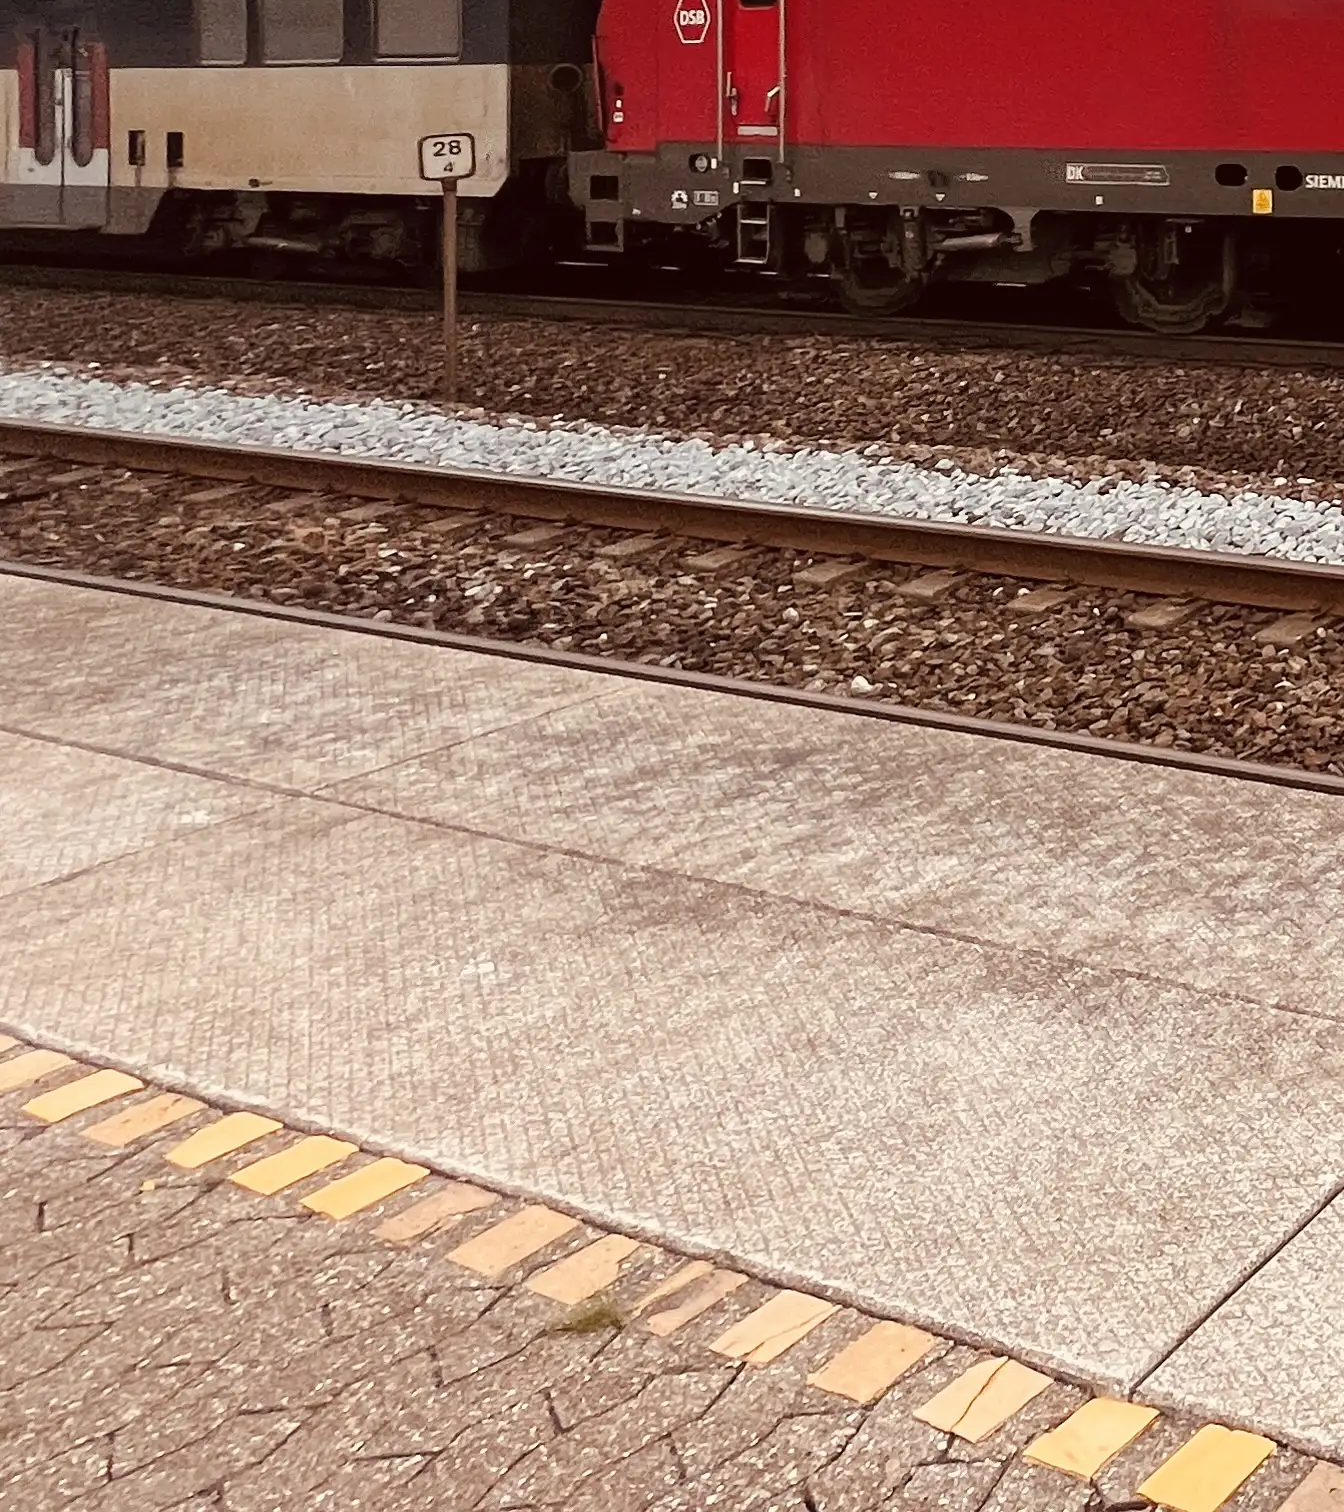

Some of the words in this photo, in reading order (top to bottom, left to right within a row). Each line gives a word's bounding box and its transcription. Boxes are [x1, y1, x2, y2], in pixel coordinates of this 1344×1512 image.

[679, 9, 705, 26] DSB
[433, 140, 462, 157] 28
[443, 162, 454, 173] 4
[1065, 165, 1084, 181] DK
